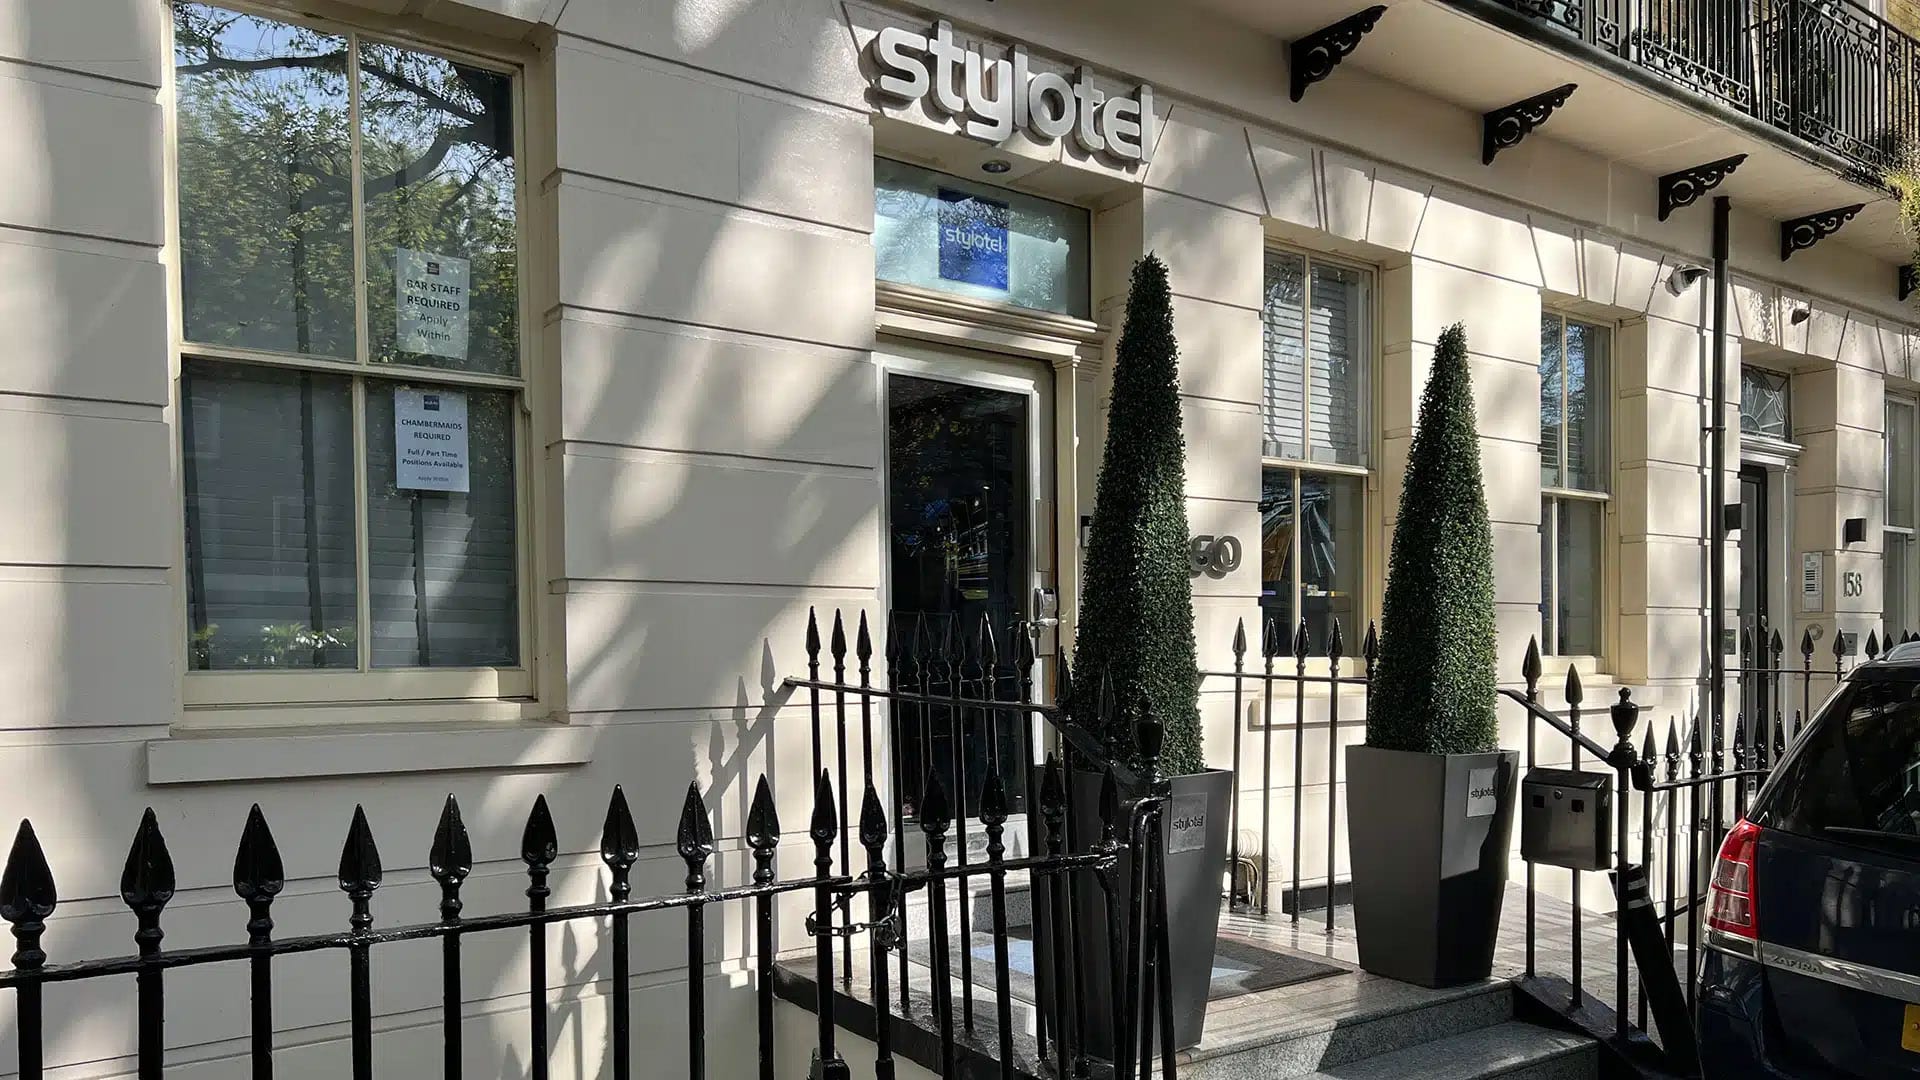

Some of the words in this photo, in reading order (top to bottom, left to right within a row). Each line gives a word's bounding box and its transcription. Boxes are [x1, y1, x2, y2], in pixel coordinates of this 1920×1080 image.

[876, 19, 1154, 164] stylotel
[945, 227, 1002, 253] stylotel
[406, 279, 428, 291] BAR
[430, 283, 461, 296] STAFF
[407, 295, 460, 312] REQUIRED
[419, 313, 448, 327] Apply
[417, 329, 451, 341] Within
[401, 419, 463, 430] CHAMBERMAIDS
[413, 431, 451, 441] REQUIRED
[407, 448, 420, 456] Full
[441, 450, 458, 458] Time
[402, 458, 433, 467] Positions
[433, 460, 463, 469] Available
[1842, 571, 1863, 597] 158
[1173, 815, 1204, 832] stylotel
[1770, 955, 1823, 975] ZAFIRA
